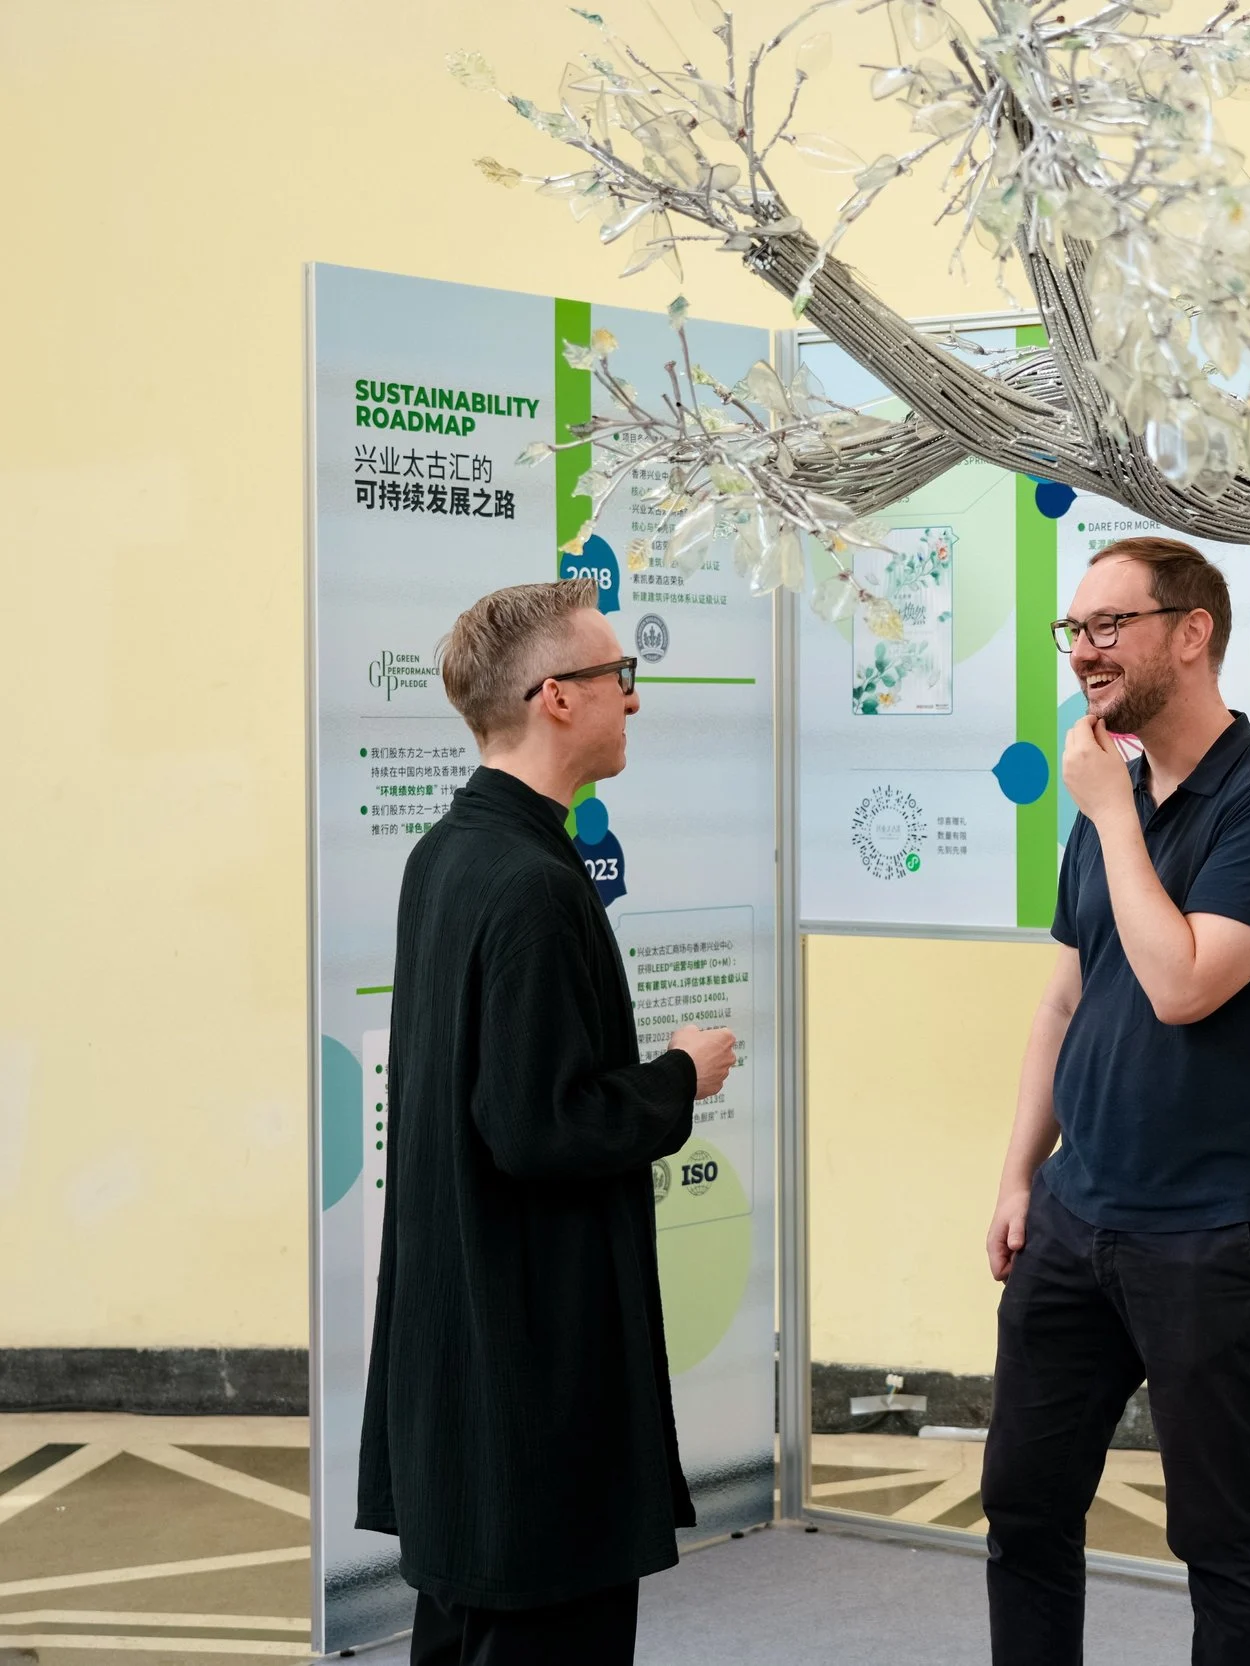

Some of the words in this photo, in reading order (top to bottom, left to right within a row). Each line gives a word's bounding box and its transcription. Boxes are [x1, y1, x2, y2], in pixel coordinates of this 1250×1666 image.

[355, 379, 540, 419] SUSTAINABILITY
[355, 405, 476, 436] ROADMAP
[354, 444, 493, 484] 兴业太古汇的
[354, 479, 516, 520] 可持续发展之路
[1088, 522, 1113, 532] DARE
[1114, 521, 1133, 531] FOR
[1134, 521, 1161, 530] MORE
[396, 654, 420, 663] GREEN
[387, 667, 440, 676] PERFORMANCE
[400, 679, 428, 688] PLEDGE
[371, 747, 466, 759] 我们股东方之一太古地产
[371, 765, 475, 778] 持续在中国内地及香港推行
[371, 804, 450, 816] 我们股东方之一太古
[585, 858, 618, 881] 023
[637, 1017, 651, 1027] ISO
[681, 1012, 694, 1022] ISO
[681, 1161, 718, 1186] ISO
